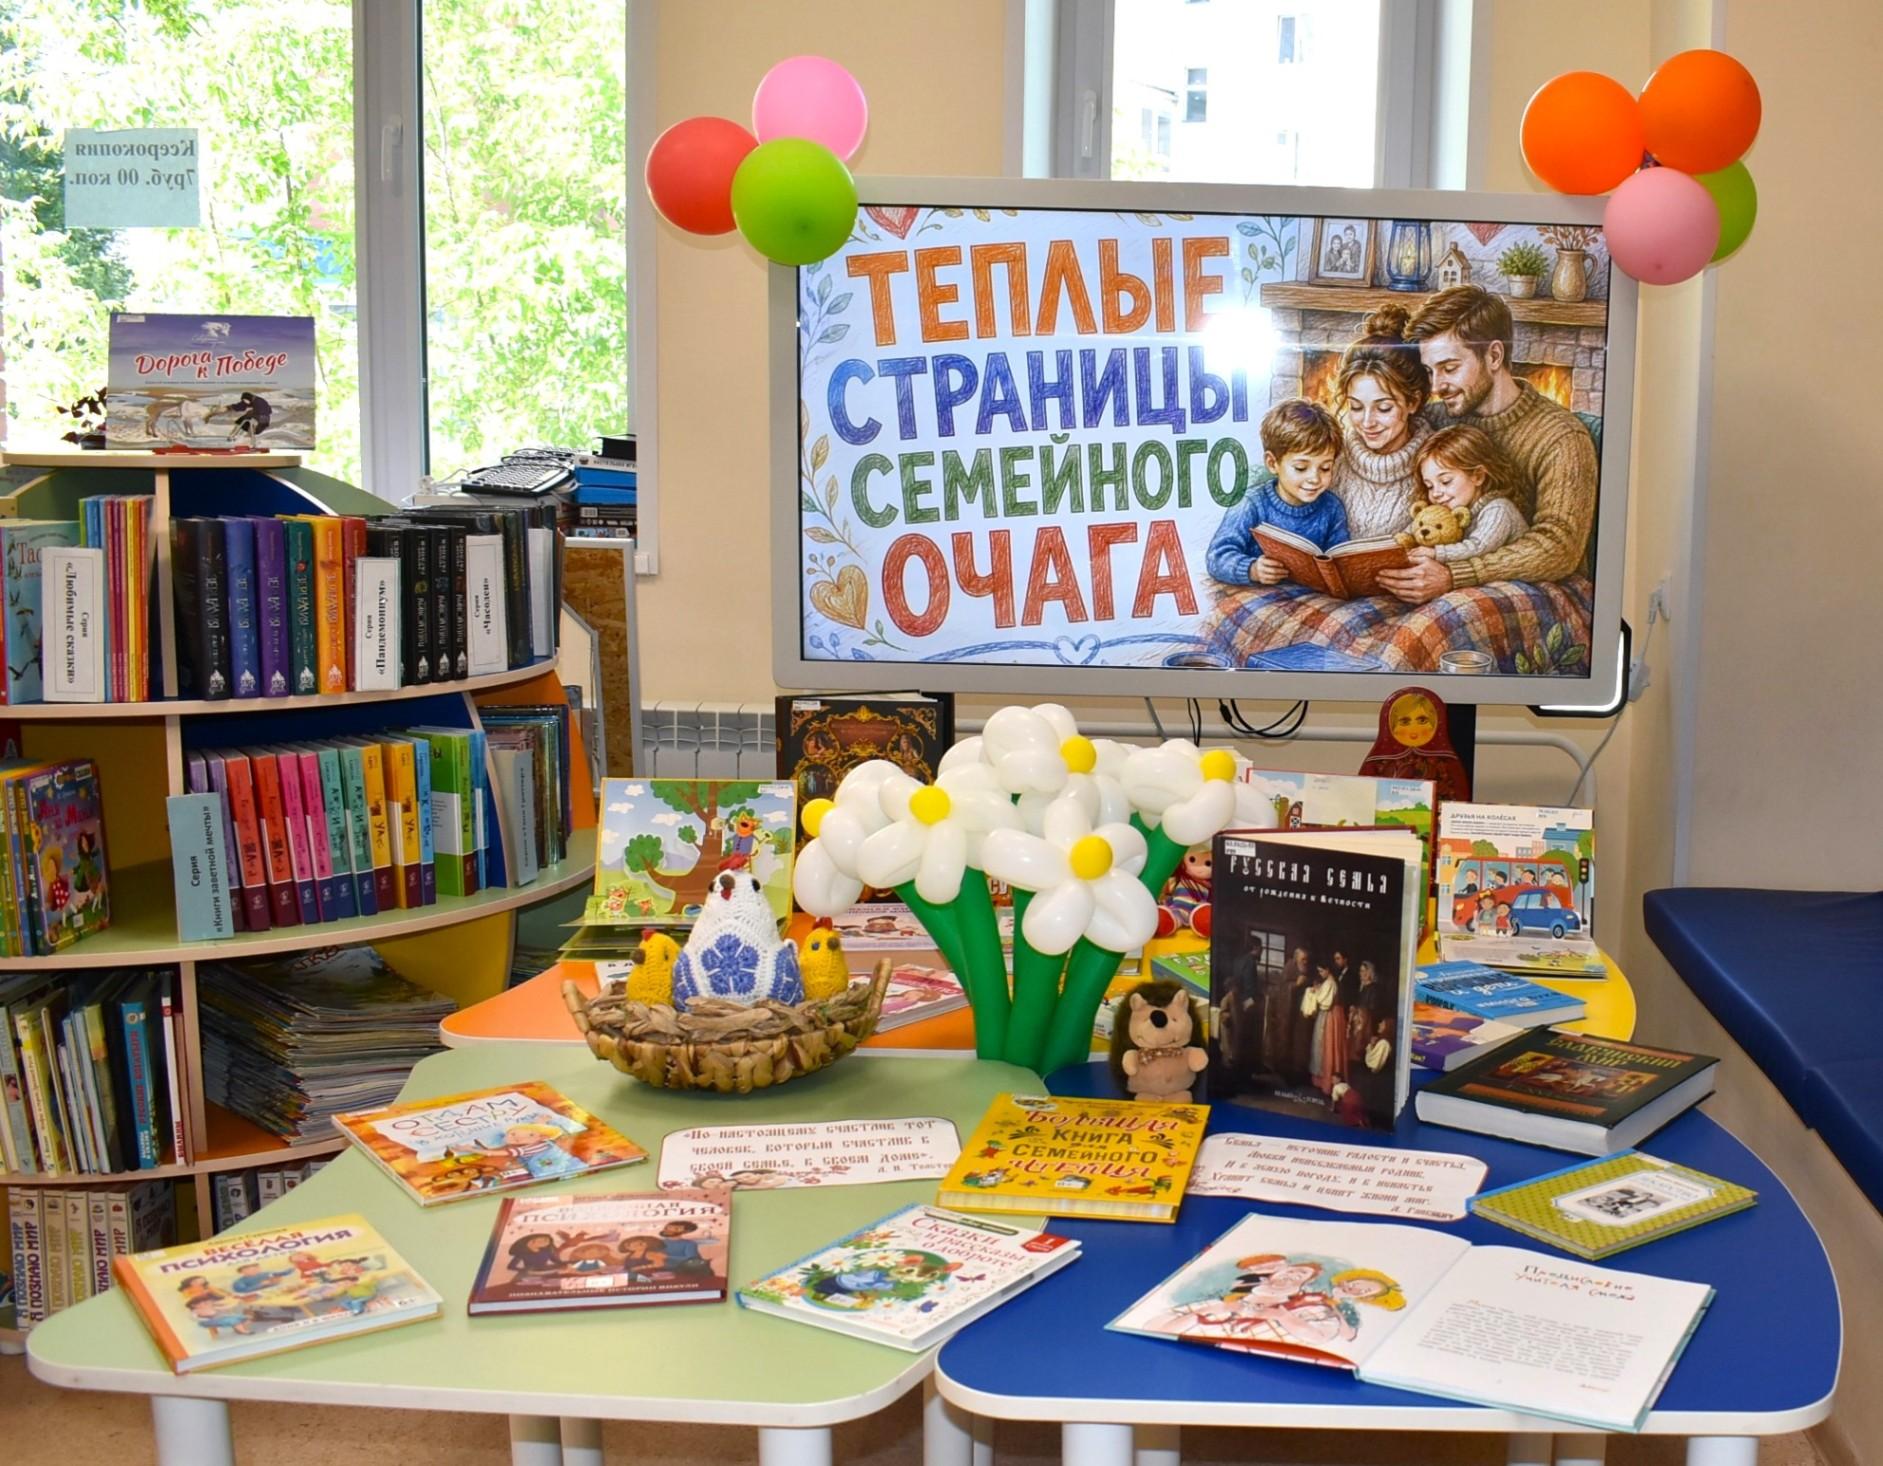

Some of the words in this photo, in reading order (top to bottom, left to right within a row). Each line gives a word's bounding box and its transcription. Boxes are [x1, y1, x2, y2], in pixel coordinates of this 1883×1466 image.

[846, 235, 1231, 348] ТЕПЛЫЕ
[135, 351, 211, 376] Дорога
[217, 350, 287, 376] Победе
[827, 344, 1249, 446] СТРАНИЦЫ
[850, 432, 1249, 530] СЕМЕЙНОГО
[881, 519, 1200, 638] ОЧАГА
[190, 855, 200, 887] Серия
[205, 847, 220, 894] заветной
[25, 1221, 39, 1250] МИР
[94, 1229, 108, 1257] МИР
[113, 1228, 127, 1256] МИР
[911, 1216, 1000, 1247] Сказки
[160, 1229, 353, 1274] ПСИХОЛОГИЯ
[27, 1253, 43, 1309] ПОЗНАЮ
[30, 1311, 43, 1322] Я
